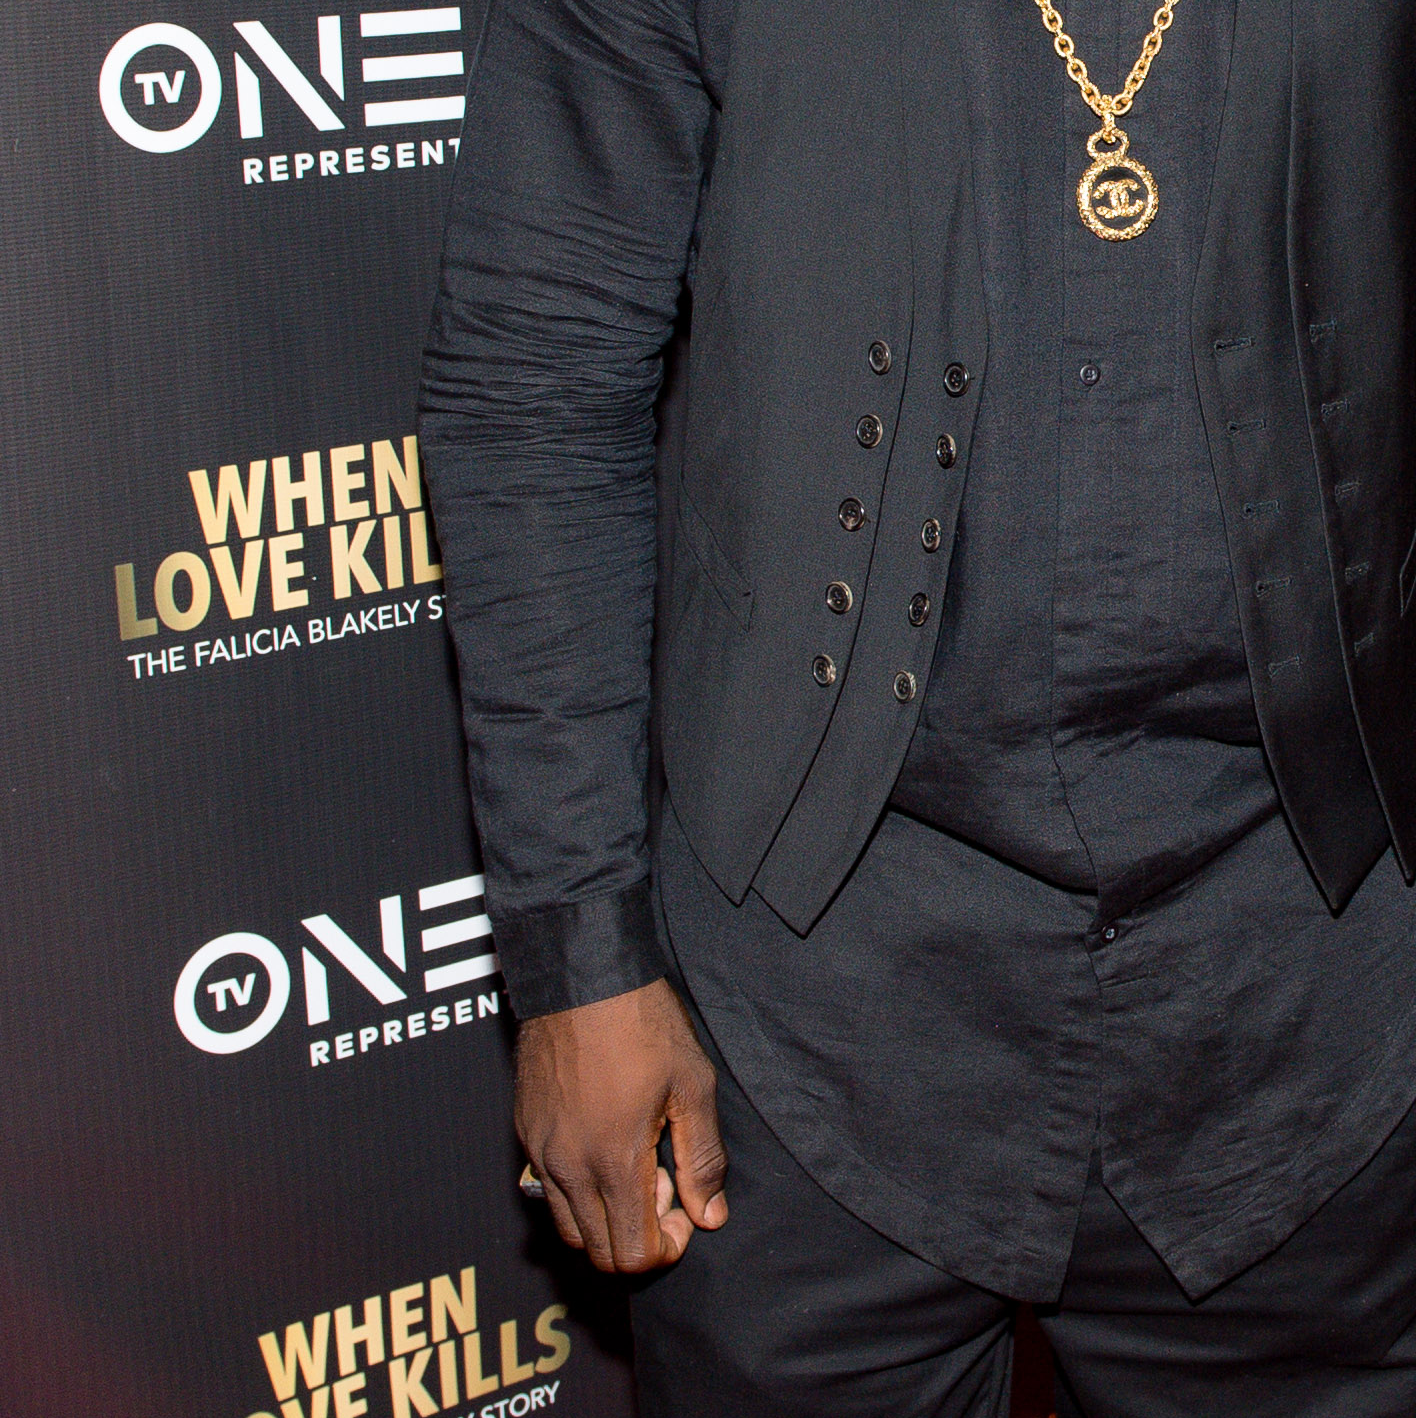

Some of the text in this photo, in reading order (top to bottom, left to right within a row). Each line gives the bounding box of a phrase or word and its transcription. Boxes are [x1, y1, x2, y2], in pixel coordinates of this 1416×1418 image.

[99, 7, 466, 153] ONE
[134, 70, 186, 105] TV
[243, 138, 461, 185] REPRESEN
[188, 434, 422, 545] WHEN
[114, 510, 445, 641] LOVE KIL
[127, 645, 187, 679] THE
[194, 624, 301, 667] FALICIA
[307, 599, 421, 644] BLAKELY
[174, 873, 500, 1054] ONE
[207, 972, 256, 1012] TV
[310, 990, 499, 1067] REPRESEN
[258, 1261, 475, 1402] WHEN
